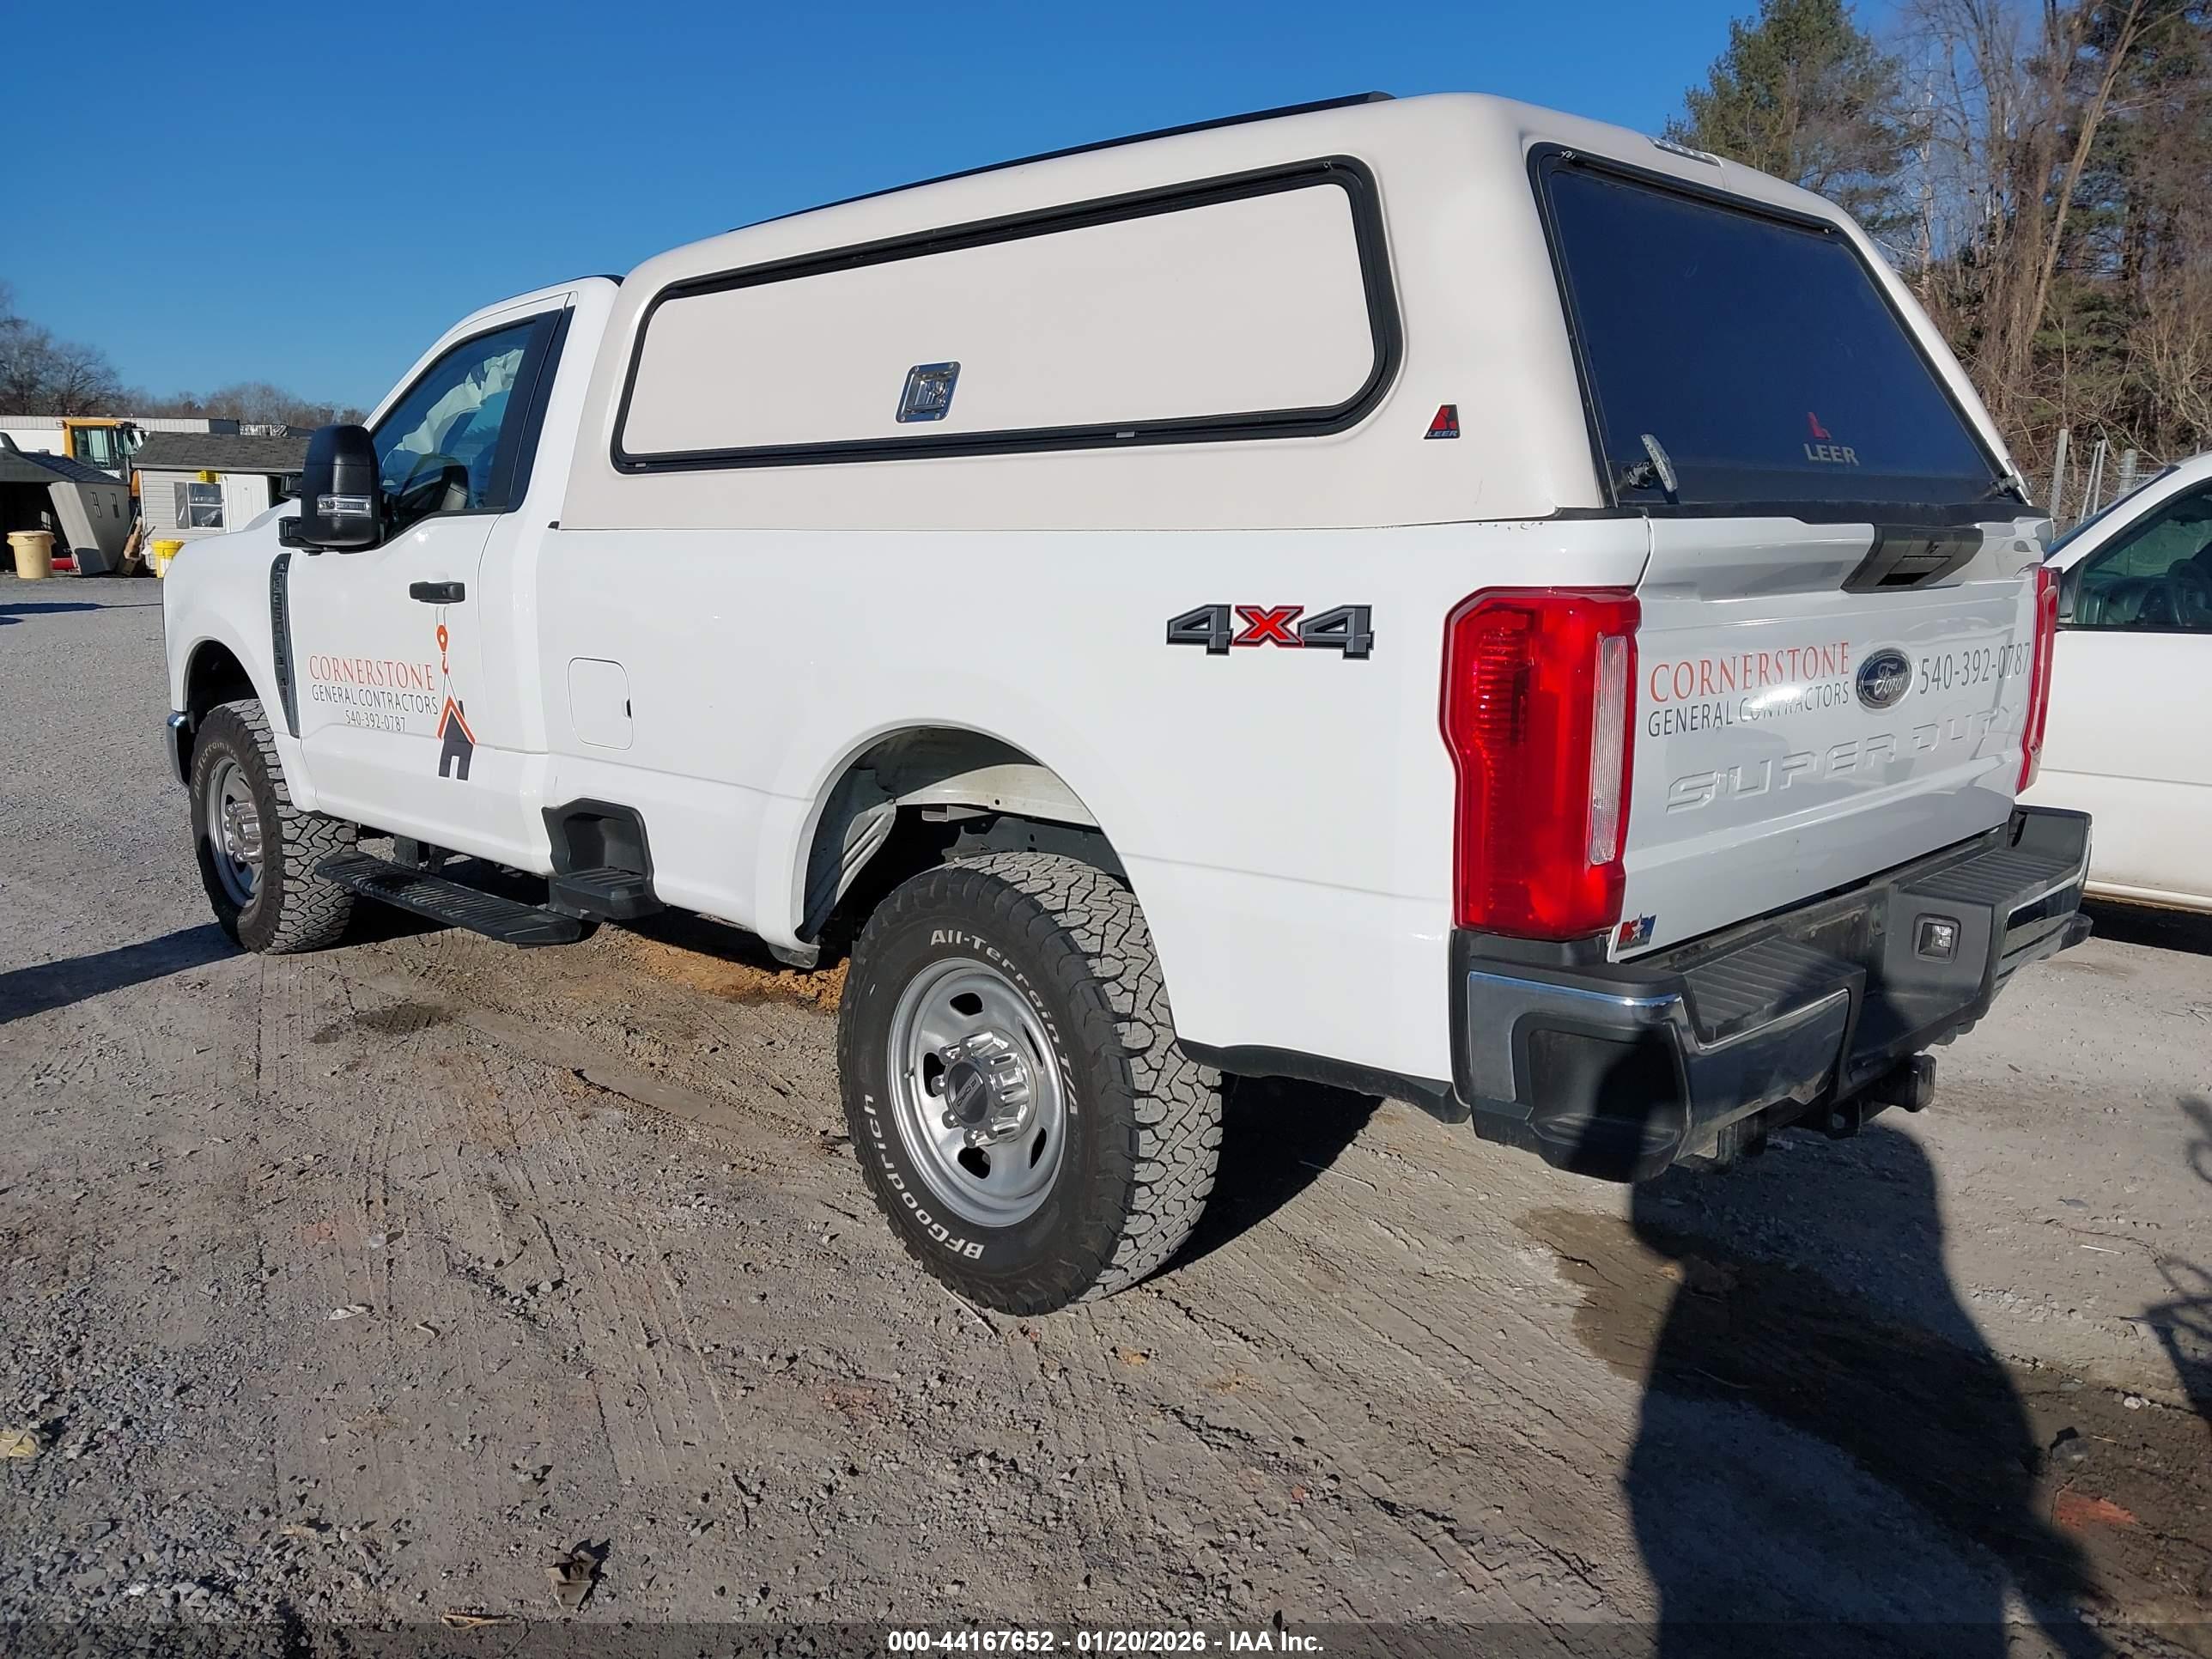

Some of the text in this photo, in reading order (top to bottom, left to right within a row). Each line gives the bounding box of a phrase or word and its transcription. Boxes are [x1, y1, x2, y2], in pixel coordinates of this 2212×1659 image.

[1803, 442, 1860, 466] LEER
[309, 655, 435, 691] CORNERSTONE
[1650, 642, 1850, 702] CORNERSTONE
[1919, 641, 2031, 695] 540-392-0787
[312, 684, 439, 715] GENERAL CONTRACTORS
[345, 710, 405, 732] 540-392-0787
[1648, 701, 1734, 738] GENERAL
[1666, 733, 1897, 814] SUPER
[931, 929, 1079, 1115] All-Terrain T/A
[864, 1094, 986, 1260] BFGoodrich
